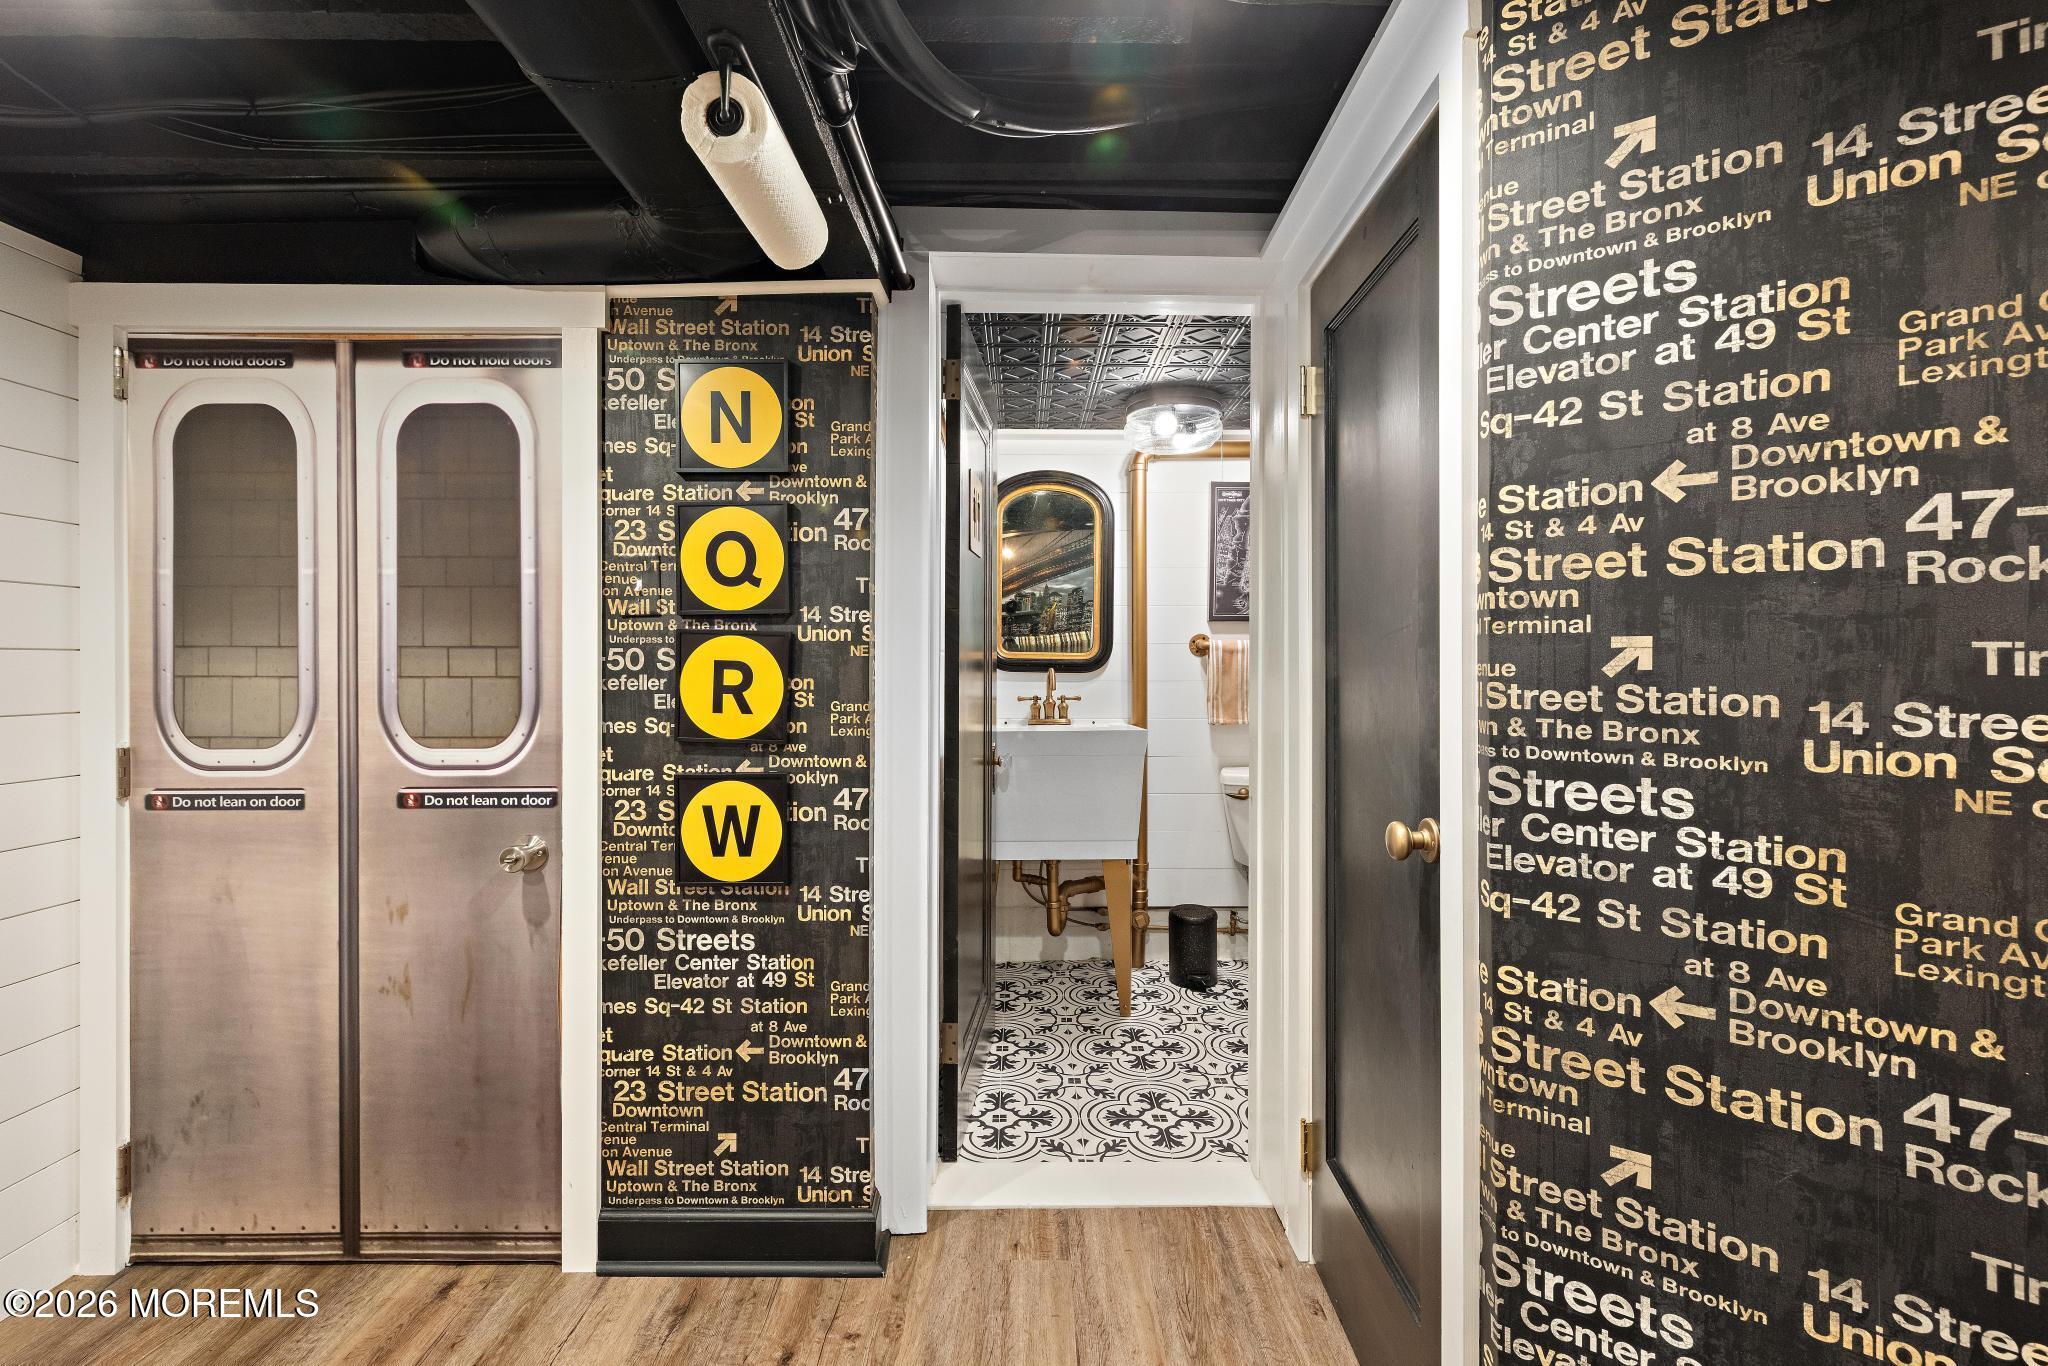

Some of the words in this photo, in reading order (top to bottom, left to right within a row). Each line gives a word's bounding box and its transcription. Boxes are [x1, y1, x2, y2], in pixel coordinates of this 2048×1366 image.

[1485, 113, 1595, 157] Terminal
[1488, 179, 1606, 234] Street
[1618, 139, 1783, 201] Station
[1808, 149, 1962, 207] Union
[1504, 261, 1523, 279] to
[1529, 237, 1637, 272] Downtown
[1644, 233, 1658, 247] &
[1666, 207, 1772, 243] Brooklyn
[1489, 258, 1697, 326] Streets
[625, 306, 673, 316] Avenue
[1522, 311, 1659, 355] Center
[1679, 275, 1850, 328] Station
[1900, 294, 2022, 335] Grand
[609, 319, 648, 336] Wall
[656, 319, 715, 336] Street
[721, 319, 789, 336] Station
[800, 326, 822, 343] 14
[608, 339, 663, 352] Uptown
[669, 340, 678, 351] &
[684, 339, 711, 350] The
[714, 339, 757, 350] Bronx
[1486, 349, 1636, 394] Elevator
[1655, 334, 1696, 366] at
[1714, 318, 1776, 353] 49
[1798, 306, 1850, 342] St
[1900, 328, 1987, 361] Park
[1480, 398, 1583, 439] Sq-42
[1599, 389, 1643, 421] St
[1663, 368, 1831, 412] Station
[710, 391, 751, 443] N
[1686, 424, 1716, 445] at
[1731, 416, 1752, 439] 8
[1768, 411, 1830, 435] Ave
[1731, 420, 1960, 470] Downtown
[1974, 415, 2009, 445] &
[663, 484, 732, 501] Station
[1731, 464, 1919, 501] Brooklyn
[1498, 477, 1643, 513] Station
[614, 520, 646, 541] 23
[706, 531, 762, 588] Q
[1488, 542, 1647, 584] Street
[1667, 531, 1885, 576] Station
[608, 619, 663, 632] Uptown
[797, 625, 851, 642] Union
[1482, 615, 1592, 634] Terminal
[712, 660, 753, 714] R
[1487, 681, 1603, 713] Street
[1616, 684, 1779, 718] Station
[1808, 701, 1869, 735] 14
[1502, 744, 1520, 758] to
[1526, 746, 1635, 765] Downtown
[1641, 749, 1656, 766] &
[1663, 751, 1769, 775] Brooklyn
[1804, 739, 1957, 779] Union
[172, 796, 191, 807] Do
[195, 796, 214, 807] not
[216, 795, 246, 807] lean
[250, 798, 266, 807] on
[270, 795, 301, 807] door
[425, 795, 443, 805] Do
[446, 795, 466, 805] not
[469, 794, 497, 805] lean
[501, 797, 518, 805] on
[522, 794, 551, 805] door
[1488, 765, 1695, 820] Streets
[702, 805, 761, 857] W
[1521, 812, 1656, 853] Center
[1676, 826, 1847, 873] Station
[608, 879, 649, 896] Wall
[800, 885, 822, 903] 14
[608, 900, 663, 913] Uptown
[668, 900, 678, 911] &
[683, 899, 710, 911] The
[714, 900, 757, 911] Bronx
[797, 906, 851, 922] Union
[609, 916, 662, 925] Underpass
[665, 916, 674, 924] to
[677, 916, 729, 924] Downtown
[732, 916, 738, 924] &
[741, 915, 785, 925] Brooklyn
[656, 928, 755, 951] Streets
[675, 955, 739, 971] Center
[747, 954, 815, 971] Station
[654, 974, 729, 990] Elevator
[736, 974, 754, 988] at
[762, 972, 786, 988] 49
[795, 971, 814, 988] St
[1496, 964, 1642, 1018] Station
[644, 998, 704, 1017] Sq-42
[712, 998, 732, 1014] St
[740, 998, 808, 1014] Station
[831, 994, 860, 1004] Park
[751, 1022, 763, 1032] at
[769, 1021, 777, 1032] 8
[783, 1021, 807, 1032] Ave
[1730, 987, 1957, 1052] Downtown
[1971, 1027, 2006, 1061] &
[662, 1044, 732, 1061] Station
[769, 1035, 852, 1048] Downtown
[856, 1034, 867, 1048] &
[1730, 1018, 1916, 1079] Brooklyn
[769, 1051, 838, 1066] Brooklyn
[646, 1066, 660, 1076] 14
[667, 1066, 681, 1076] St
[687, 1066, 696, 1076] &
[702, 1066, 711, 1076] 4
[717, 1066, 732, 1076] Av
[613, 1081, 647, 1101] 23
[657, 1081, 734, 1102] Street
[742, 1081, 827, 1102] Station
[1490, 1026, 1646, 1096] Street
[1664, 1063, 1884, 1152] Station
[612, 1103, 704, 1117] Downtown
[1488, 1095, 1592, 1136] Terminal
[651, 1121, 710, 1132] Terminal
[622, 1147, 672, 1157] Avenue
[606, 1160, 647, 1176] Wall
[654, 1160, 715, 1176] Street
[720, 1160, 789, 1176] Station
[800, 1166, 822, 1183] 14
[606, 1180, 663, 1193] Uptown
[667, 1180, 677, 1191] &
[682, 1180, 709, 1191] The
[714, 1180, 757, 1191] Bronx
[797, 1186, 852, 1202] Union
[608, 1196, 661, 1205] Underpass
[665, 1196, 674, 1204] to
[677, 1196, 729, 1204] Downtown
[731, 1196, 738, 1204] &
[740, 1196, 785, 1205] Brooklyn
[1490, 1159, 1604, 1219] Street
[1615, 1196, 1779, 1272] Station
[1506, 1198, 1527, 1223] &
[1534, 1207, 1592, 1244] The
[1601, 1226, 1700, 1279] Bronx
[1501, 1225, 1520, 1243] to
[1525, 1231, 1634, 1280] Downtown
[1640, 1269, 1656, 1287] &
[1663, 1277, 1768, 1325] Brooklyn
[1490, 1243, 1694, 1350] Streets
